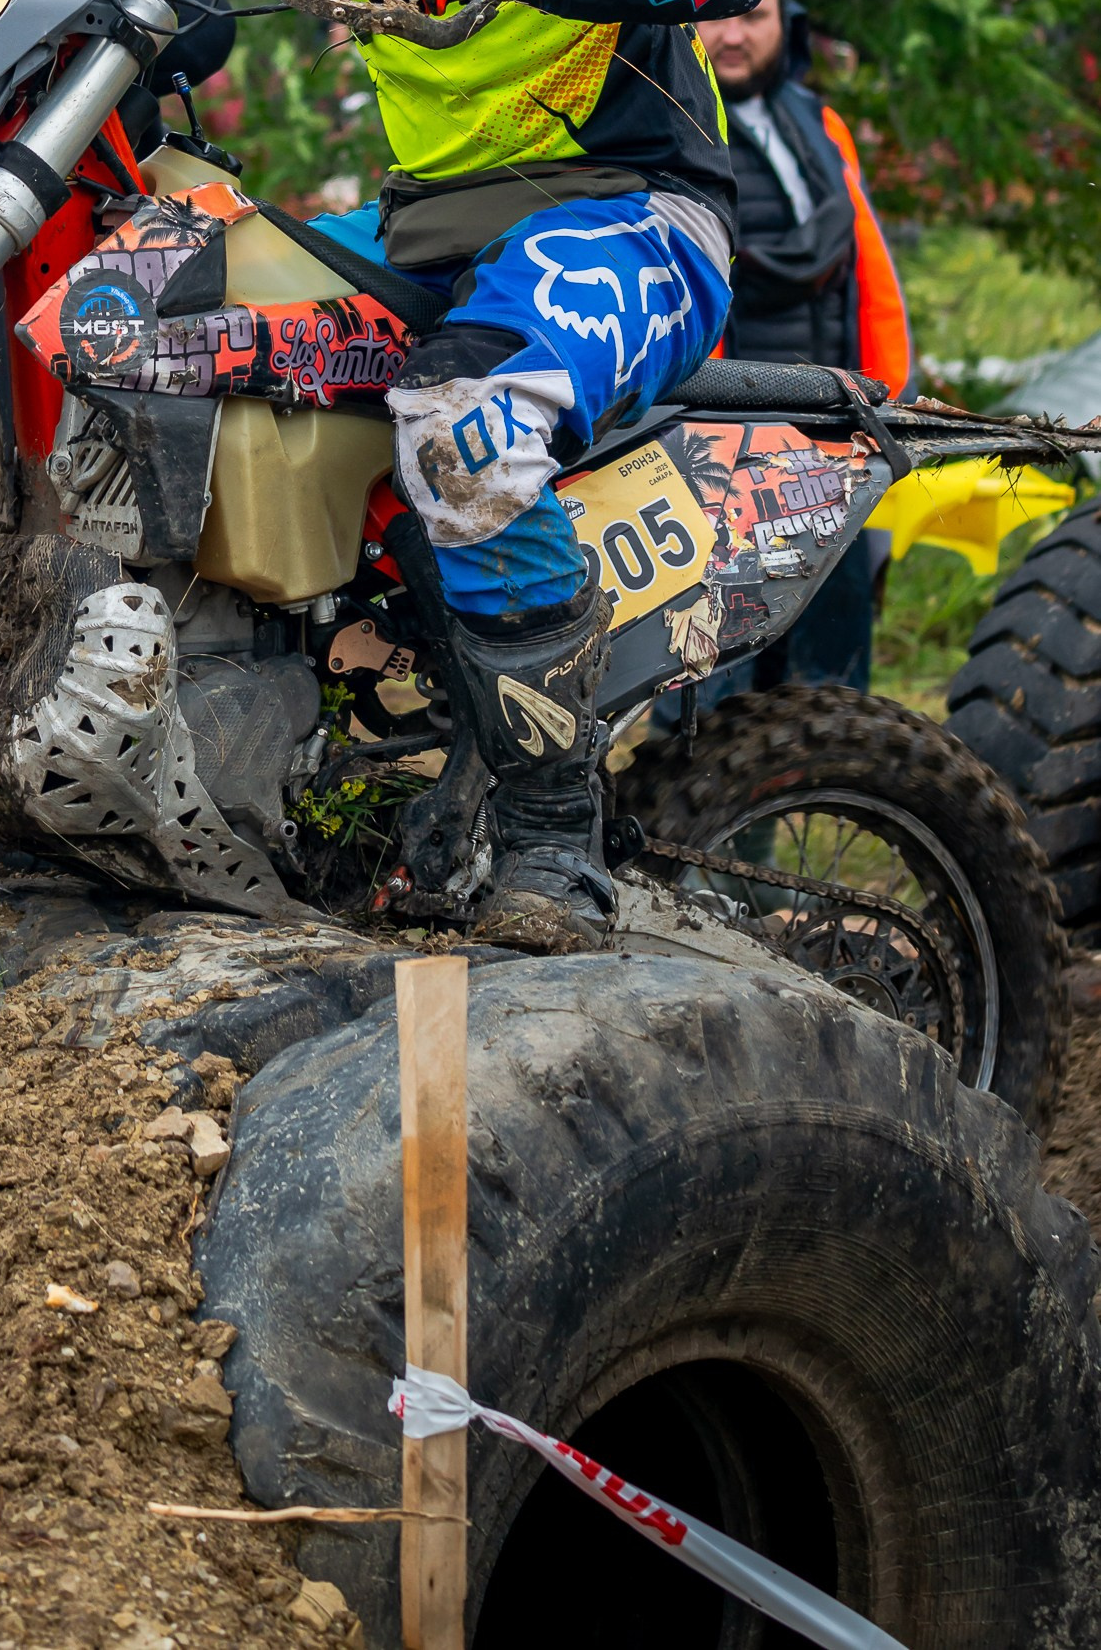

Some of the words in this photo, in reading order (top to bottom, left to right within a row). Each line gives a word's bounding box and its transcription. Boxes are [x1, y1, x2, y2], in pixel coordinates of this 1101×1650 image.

[273, 318, 318, 369] Los
[299, 317, 403, 407] Santos
[617, 449, 663, 479] БРОНЗА
[654, 462, 669, 475] 2025
[648, 470, 674, 487] САМАРА
